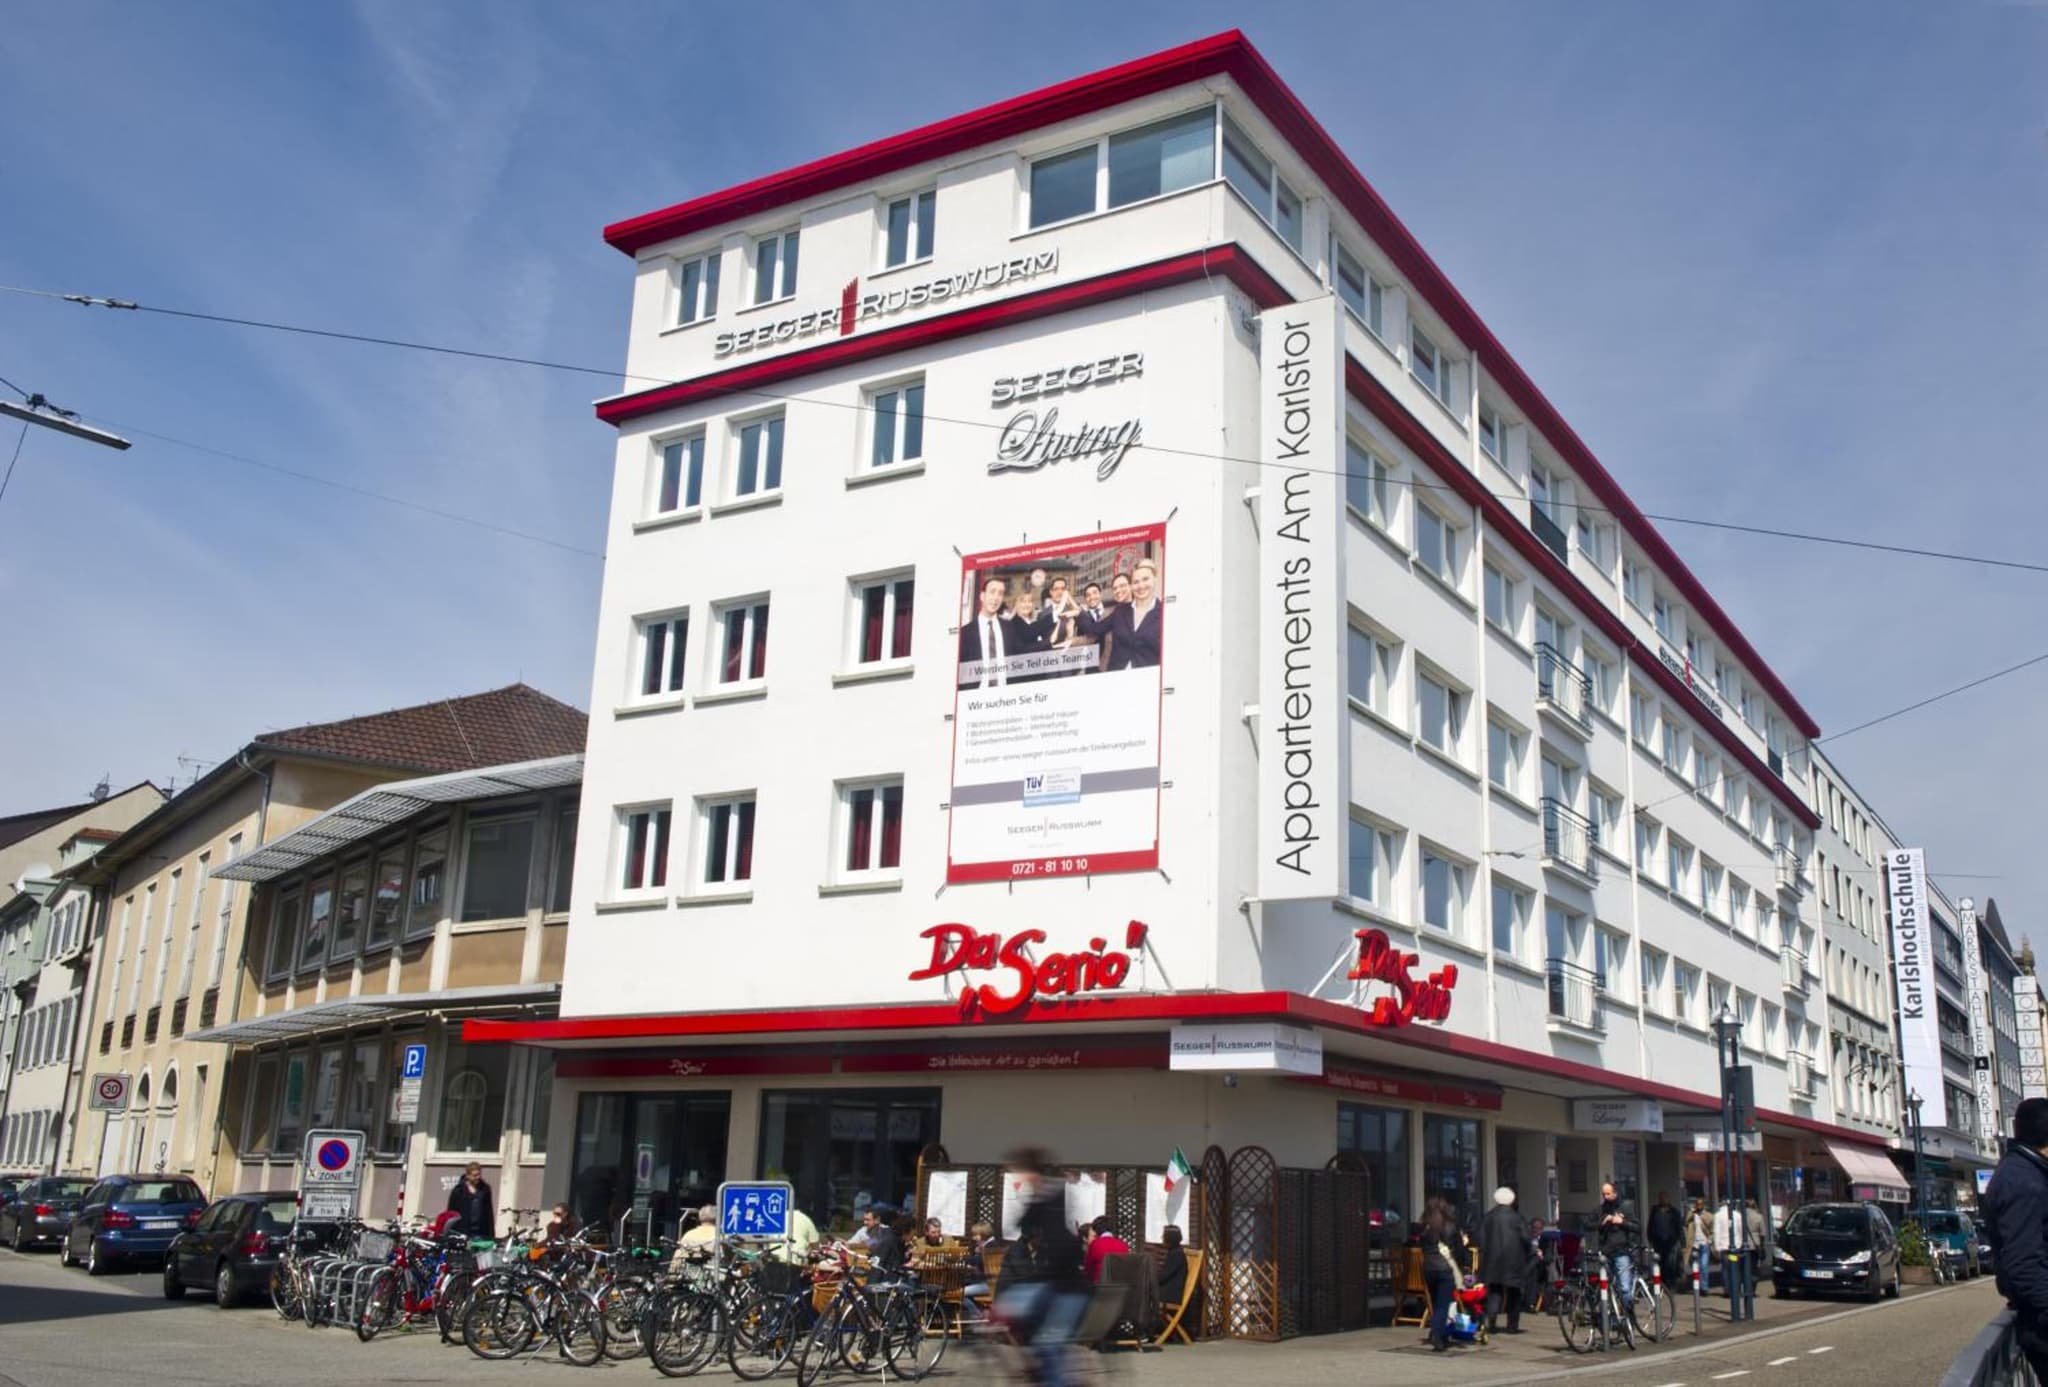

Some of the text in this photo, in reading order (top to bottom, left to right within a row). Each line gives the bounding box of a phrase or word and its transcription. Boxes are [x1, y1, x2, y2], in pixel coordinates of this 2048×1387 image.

[714, 247, 1060, 359] SEEGER RUSSWURM
[991, 352, 1143, 408] SEEGER
[987, 407, 1143, 482] Living
[1276, 321, 1320, 876] Appartements Am Karlstor
[1011, 661, 1024, 670] Sie
[1027, 658, 1041, 668] Teil
[1043, 656, 1060, 666] des
[968, 693, 1049, 711] Wir suchen Sie für
[1026, 775, 1044, 790] TÜV
[1007, 822, 1043, 834] SEEGER
[1012, 862, 1035, 875] 0721
[1045, 861, 1057, 873] 81
[1061, 860, 1073, 871] 10
[1076, 859, 1088, 870] 10
[1891, 853, 1923, 1019] Karlshochschule
[908, 922, 1002, 981] Da
[1962, 912, 1984, 1055] MARKSTAHLER
[1979, 1071, 1993, 1137] BARTH
[2019, 976, 2040, 1063] FORUM
[1173, 1041, 1211, 1051] SEEGER
[1217, 1041, 1272, 1050] RUSSWURM
[406, 1049, 419, 1075] P
[105, 1084, 118, 1094] 30
[319, 1171, 343, 1181] ZONE
